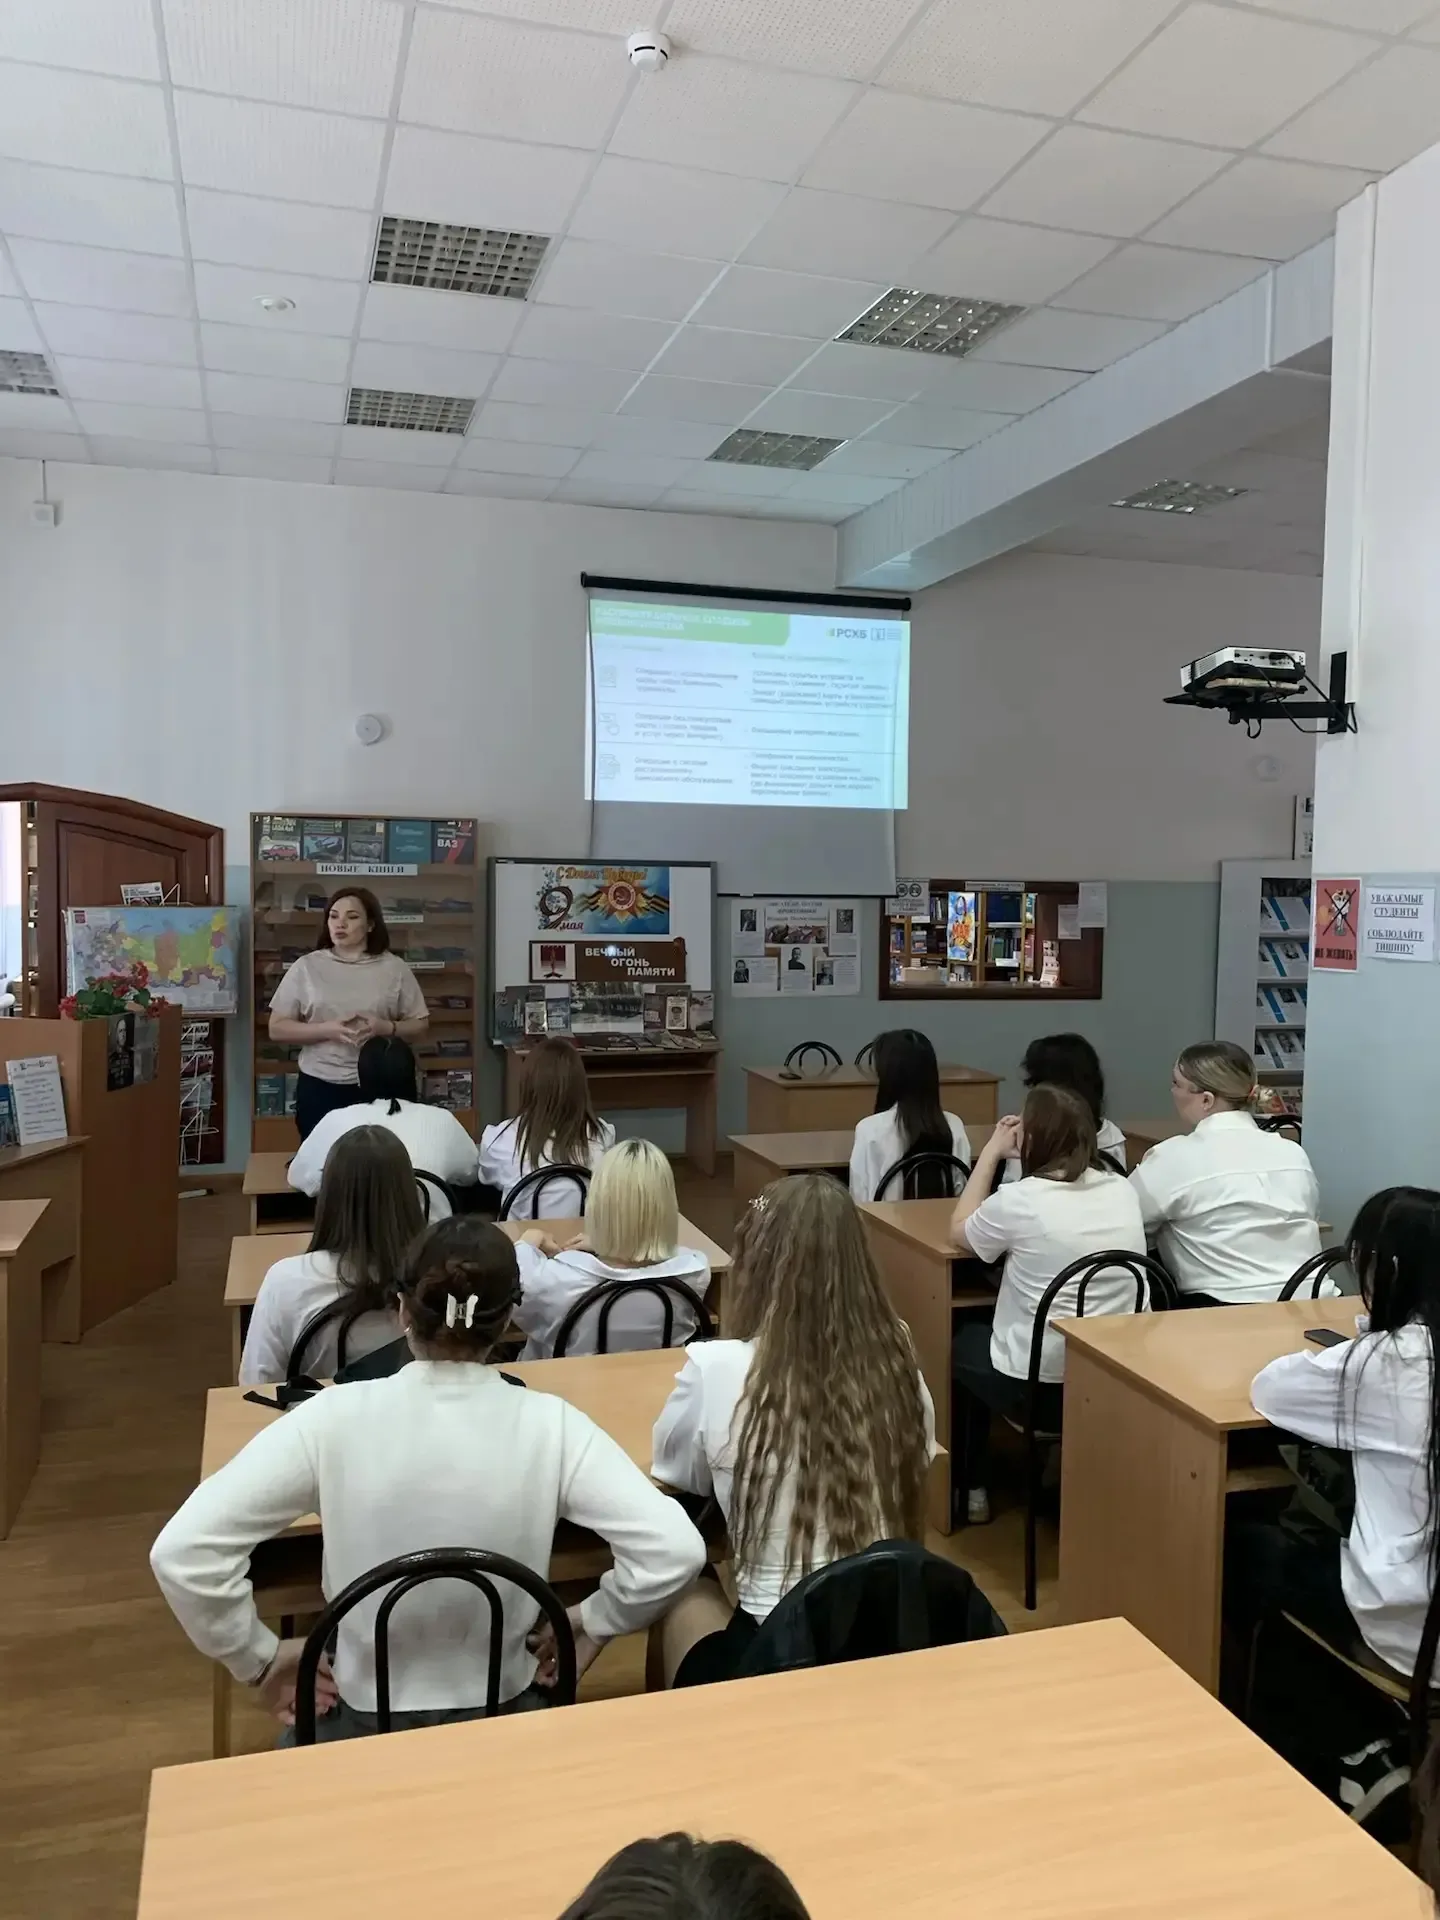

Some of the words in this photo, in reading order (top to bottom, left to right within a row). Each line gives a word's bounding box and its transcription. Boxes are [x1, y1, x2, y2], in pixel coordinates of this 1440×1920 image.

[836, 628, 868, 640] РСХБ
[437, 838, 458, 848] ВАЗ
[320, 864, 360, 873] НОВЫЕ
[367, 865, 405, 874] КНИГИ
[556, 866, 565, 880] С
[1371, 893, 1424, 904] УВАЖАЕМЫЕ
[1374, 907, 1419, 918] СТУДЕНТЫ
[559, 921, 584, 931] мая
[1367, 928, 1425, 941] СОБЛЮДАЙТЕ
[1376, 942, 1415, 954] ТИШИНУ!
[610, 958, 650, 967] ОГОНЬ
[627, 968, 675, 976] ПАМЯТИ
